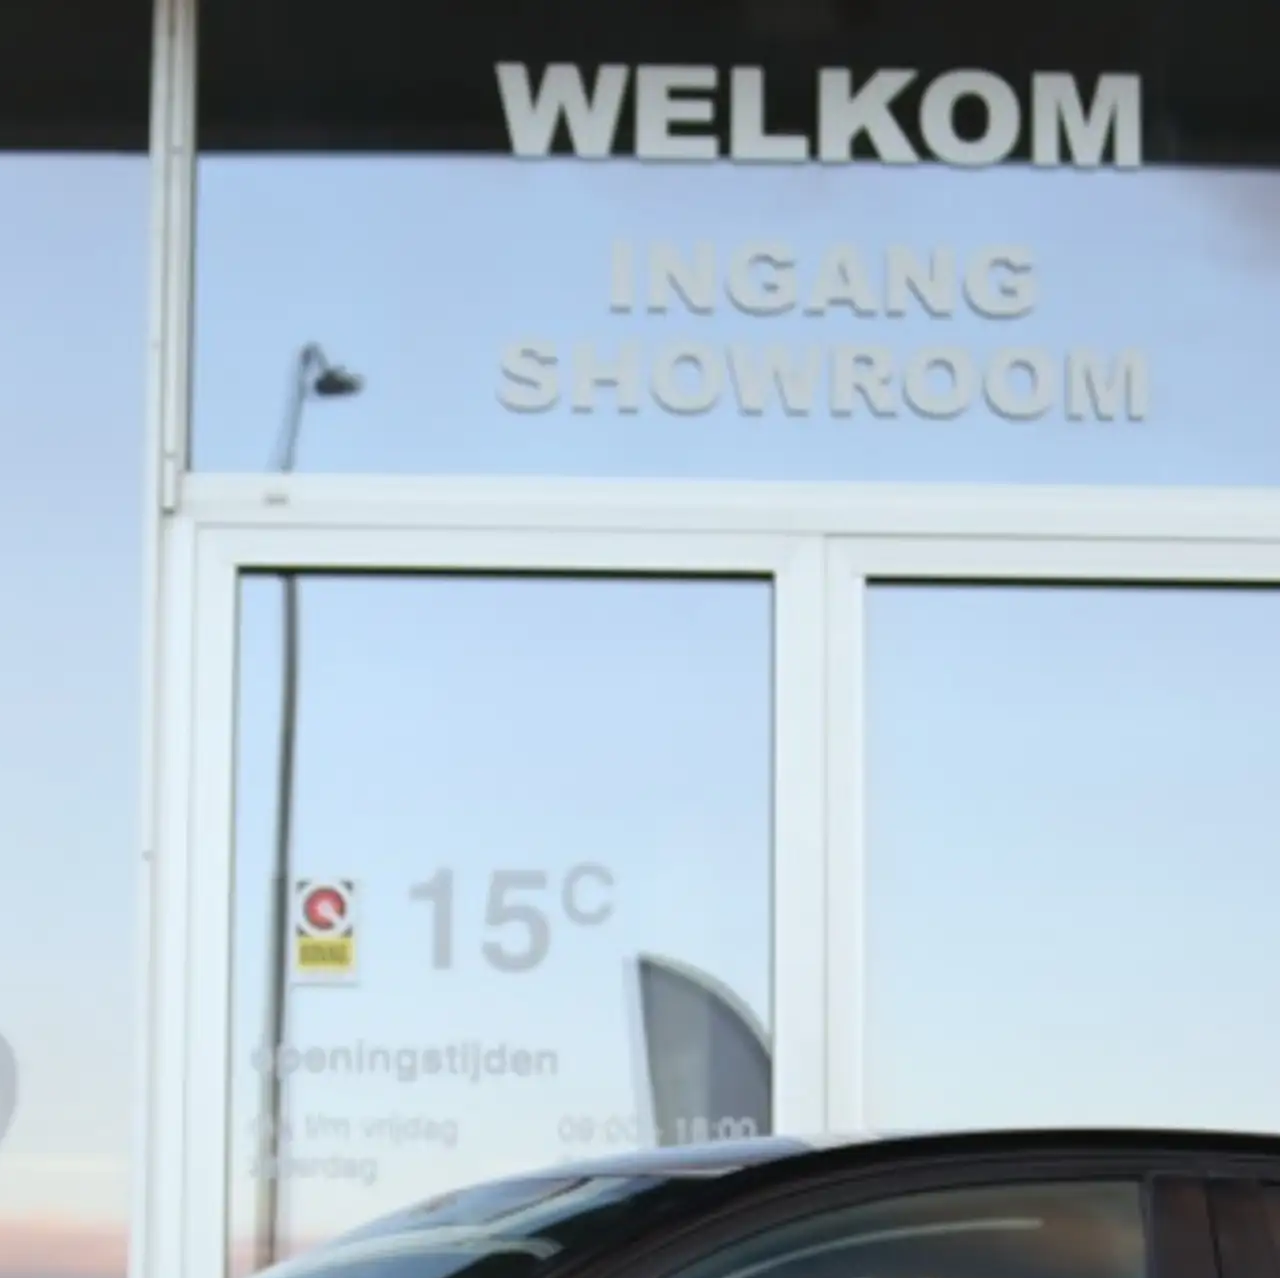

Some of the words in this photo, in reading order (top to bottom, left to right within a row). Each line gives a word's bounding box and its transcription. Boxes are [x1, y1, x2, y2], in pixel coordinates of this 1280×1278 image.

[495, 62, 1142, 169] WELKOM
[609, 238, 1038, 321] INGANG
[494, 339, 1151, 422] SHOWROOM
[249, 1038, 559, 1083] openingstijden
